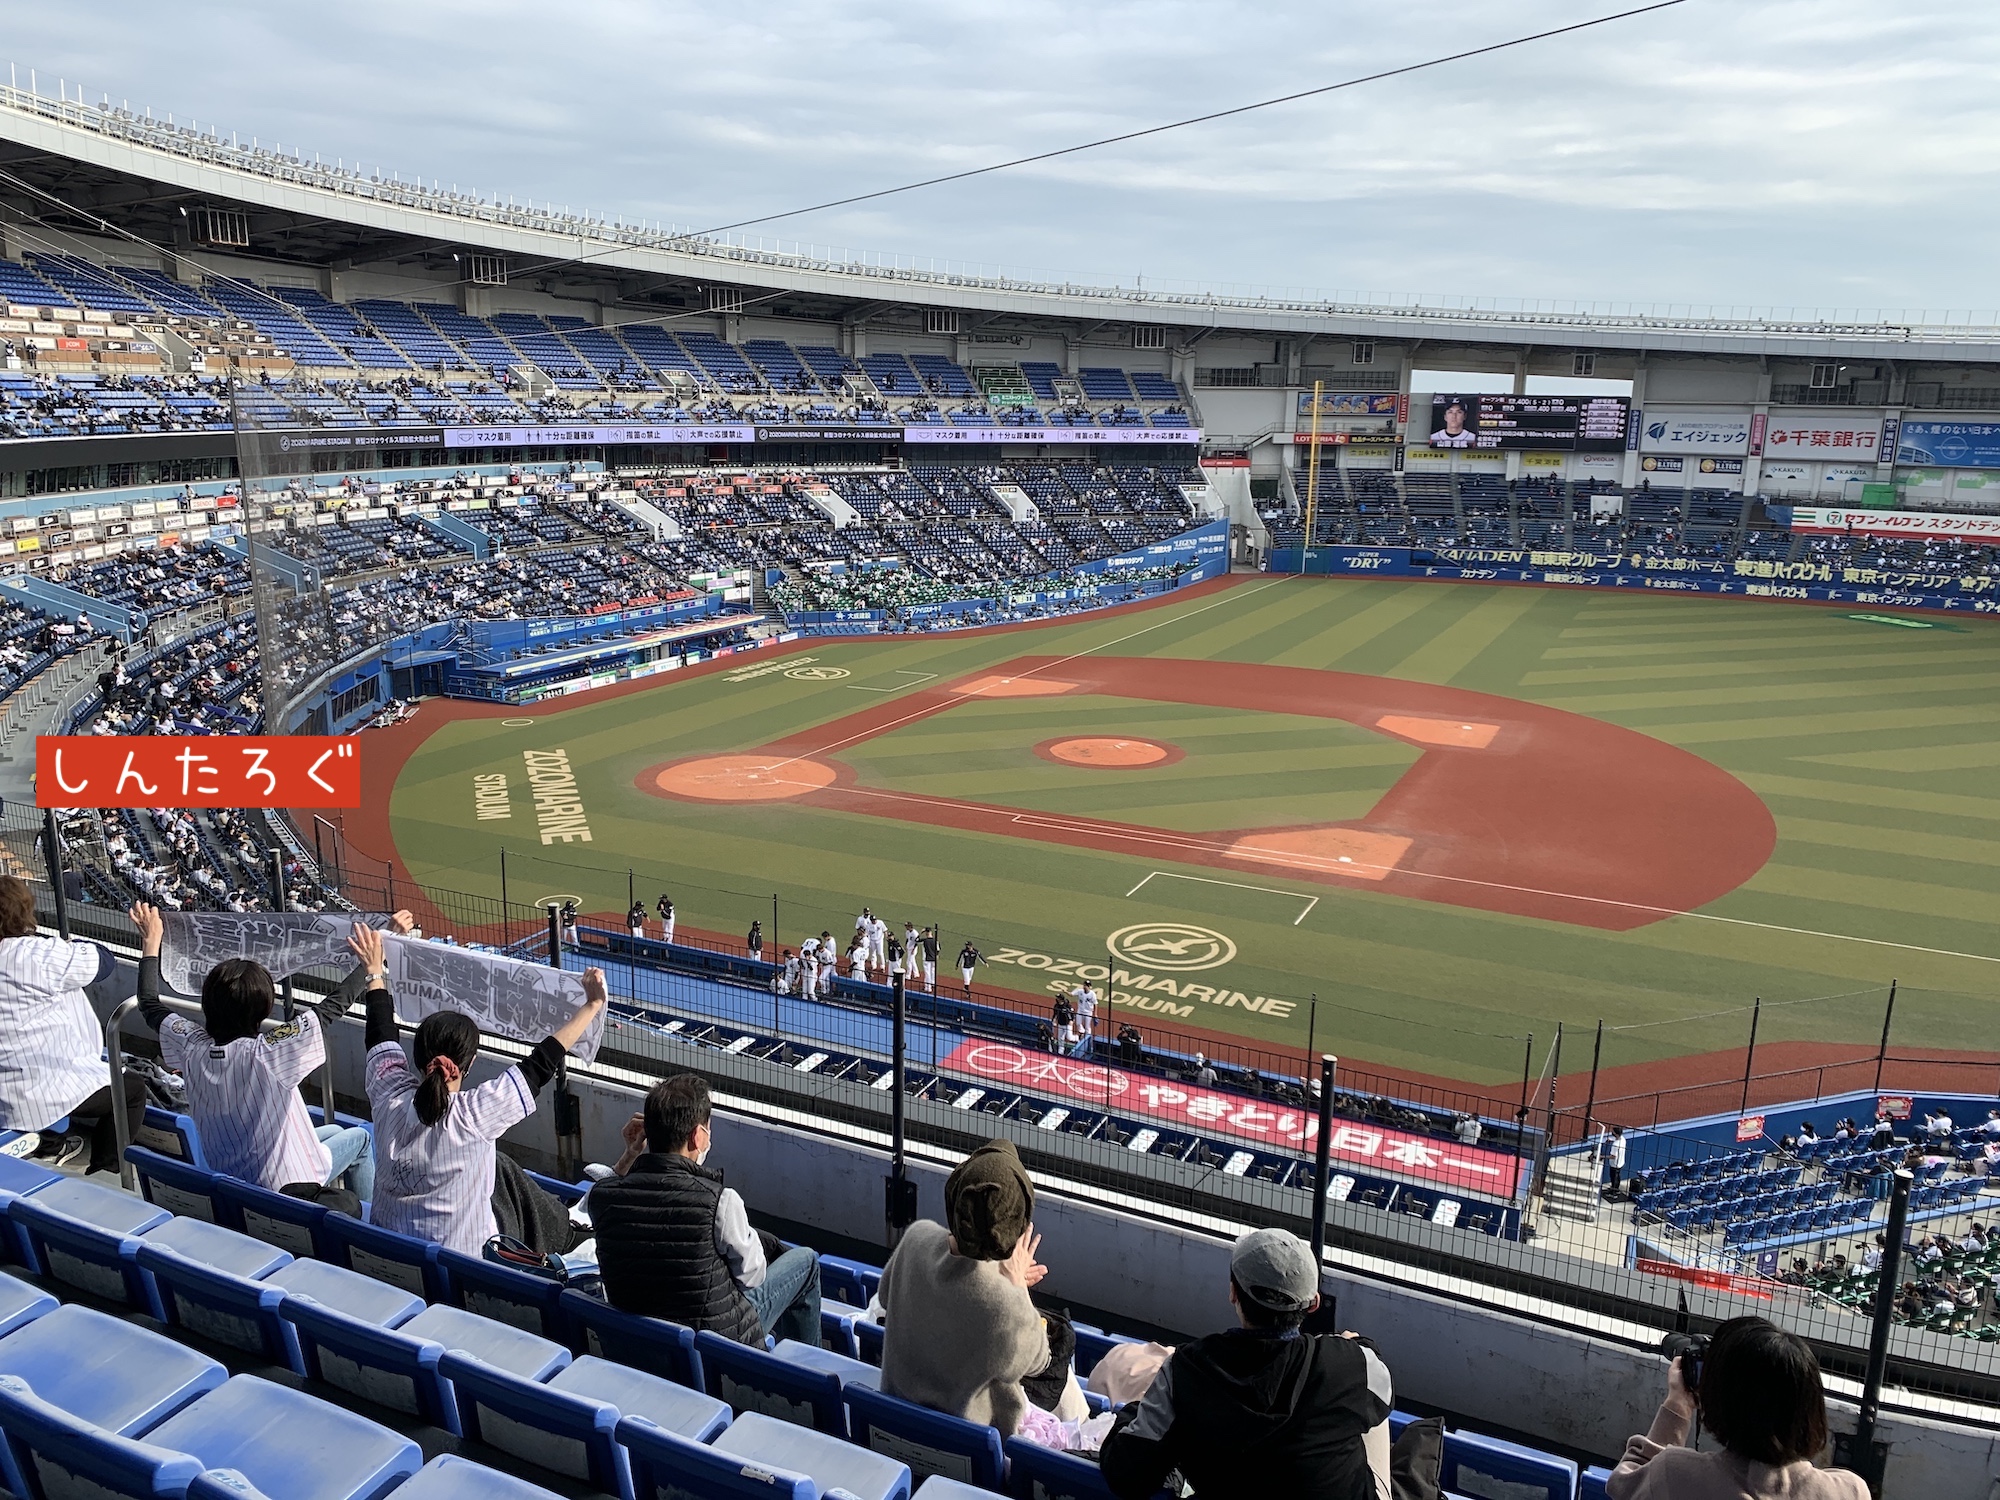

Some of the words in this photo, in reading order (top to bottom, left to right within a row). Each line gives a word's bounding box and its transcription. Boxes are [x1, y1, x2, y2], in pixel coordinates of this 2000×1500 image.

[477, 432, 512, 442] マスク着用
[545, 431, 595, 440] 十分な距離確保
[690, 430, 744, 440] 大声での応援禁止
[935, 431, 968, 439] マスク着用
[1671, 431, 1747, 443] エイジェック
[1790, 430, 1877, 448] 千葉銀行
[1530, 551, 1622, 568] 新東京グループ
[1645, 556, 1725, 573] 金太郎ホーム
[1460, 567, 1498, 578] カナデン
[1734, 559, 1835, 582] 東進ハイスクール
[1843, 567, 1952, 589] 東京インテリア
[1653, 580, 1701, 590] 金太郎ホーム
[1745, 584, 1809, 599] 東進ハイスクール
[1856, 593, 1923, 606] 東京インテリア
[473, 773, 511, 820] STADIUM
[523, 748, 593, 845] ZOZOMARINE
[987, 947, 1298, 1019] ZOZOMARINE
